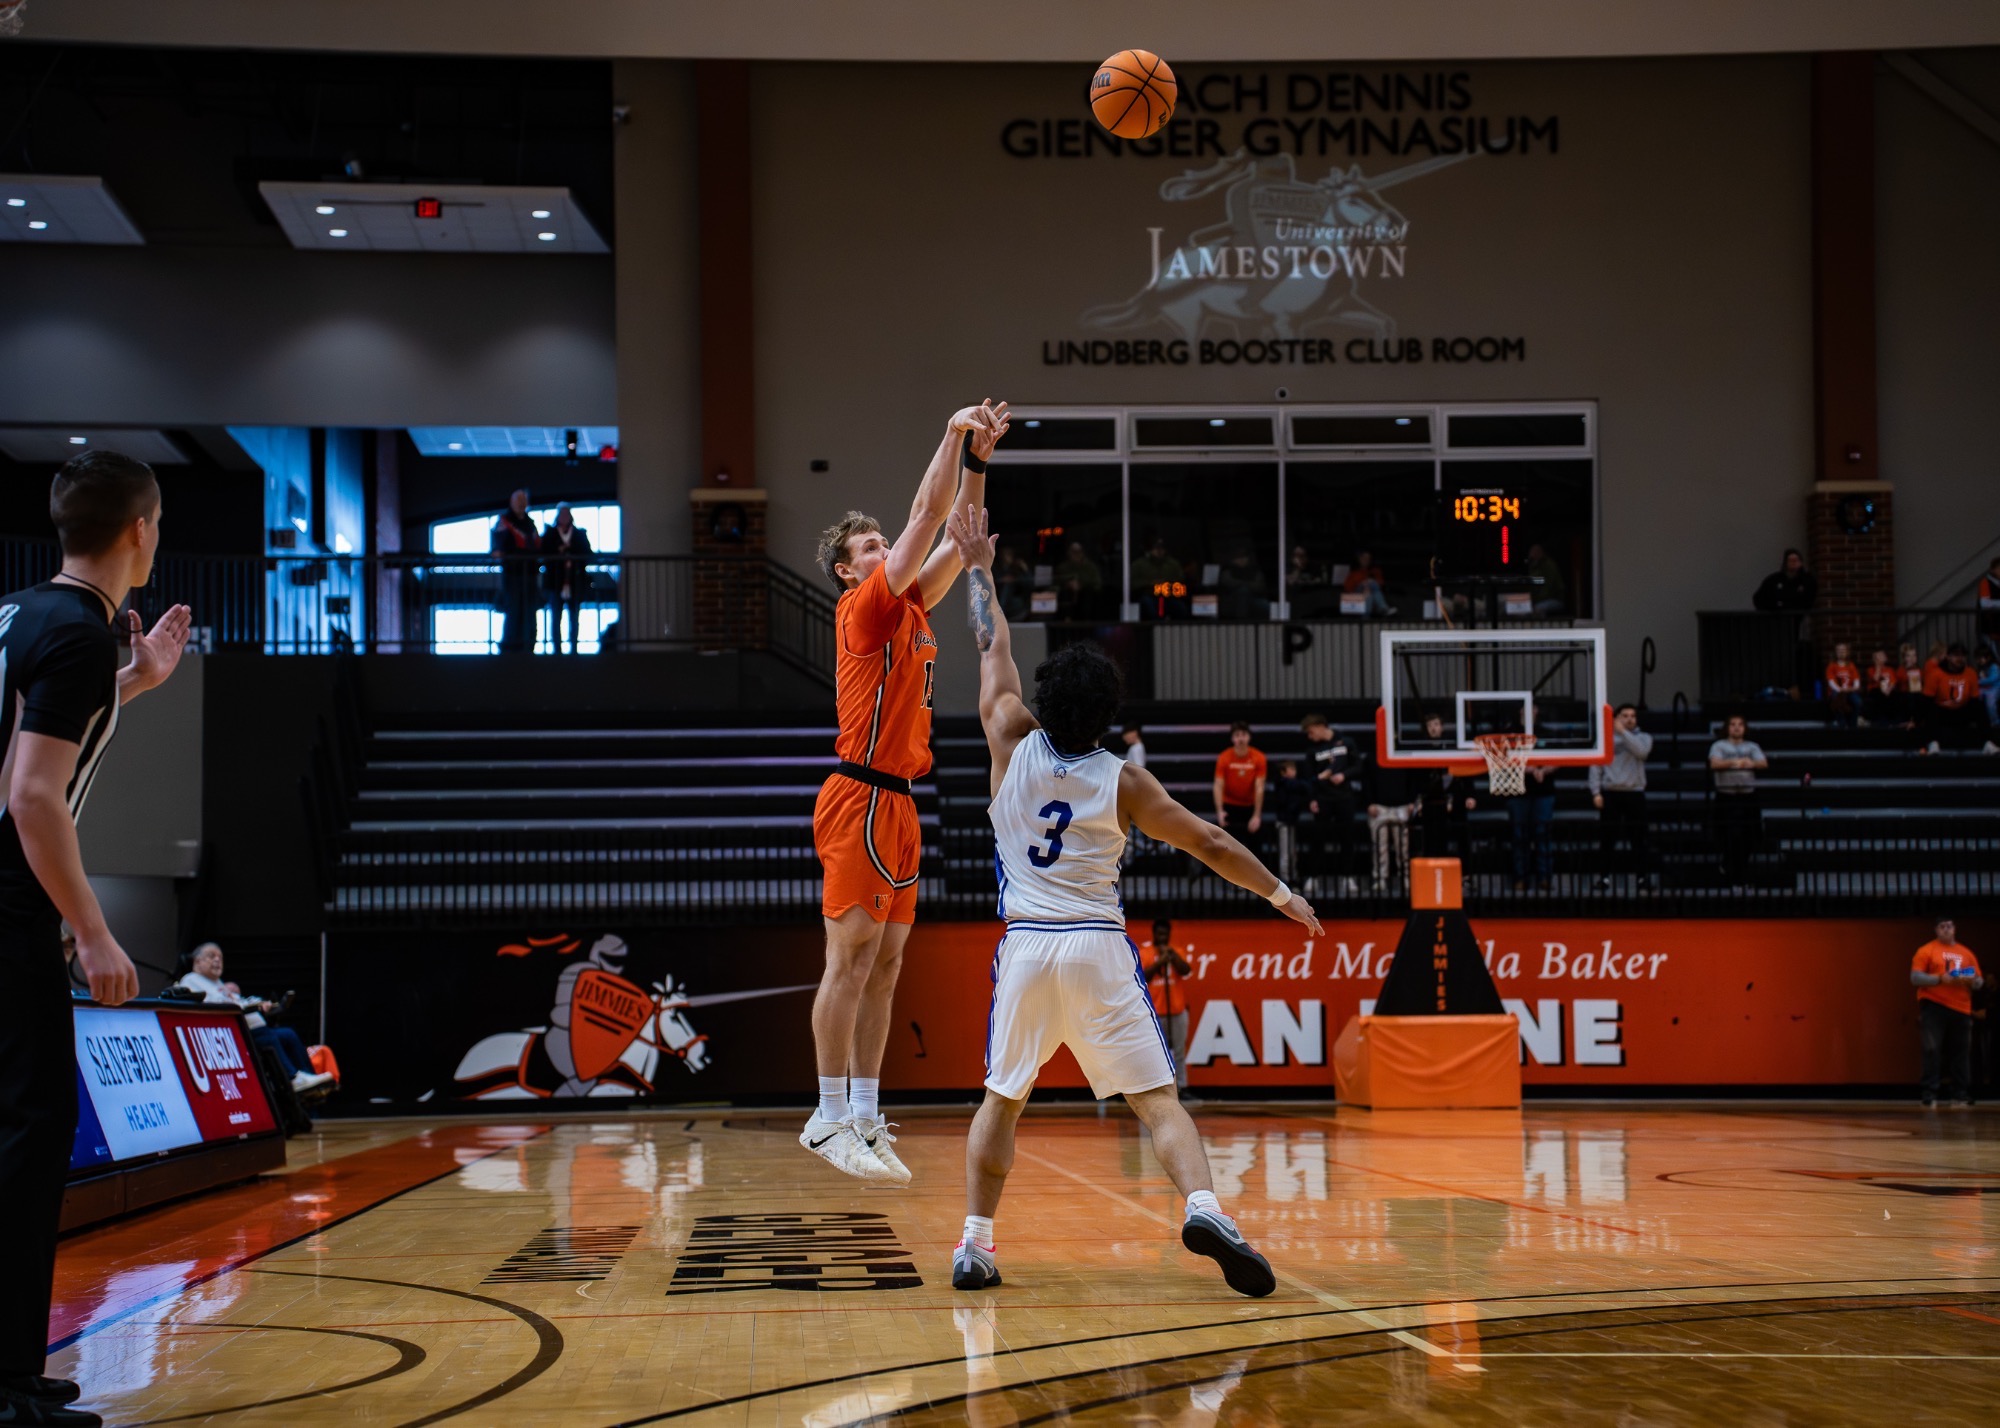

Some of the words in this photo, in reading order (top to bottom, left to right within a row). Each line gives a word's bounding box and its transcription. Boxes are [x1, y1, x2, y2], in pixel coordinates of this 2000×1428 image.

[1084, 74, 1269, 113] ACH
[1286, 72, 1473, 112] DENNIS
[1243, 116, 1559, 157] GYMNASIUM
[1276, 218, 1386, 243] University
[1146, 227, 1407, 289] JAMESTOWN
[1042, 339, 1190, 366] LINDBERG
[1199, 339, 1337, 365] BOOSTER
[1345, 338, 1424, 363] CLUB
[1431, 336, 1526, 363] ROOM
[1454, 495, 1521, 523] 10:34
[1027, 799, 1073, 868] 3
[1231, 943, 1321, 980] and
[1538, 939, 1668, 980] Baker
[1432, 915, 1449, 1012] JIMMIES
[576, 979, 646, 1021] JIMMIES
[1185, 999, 1325, 1066] AN
[84, 1034, 162, 1088] SANFORD
[123, 1101, 169, 1132] HEALTH
